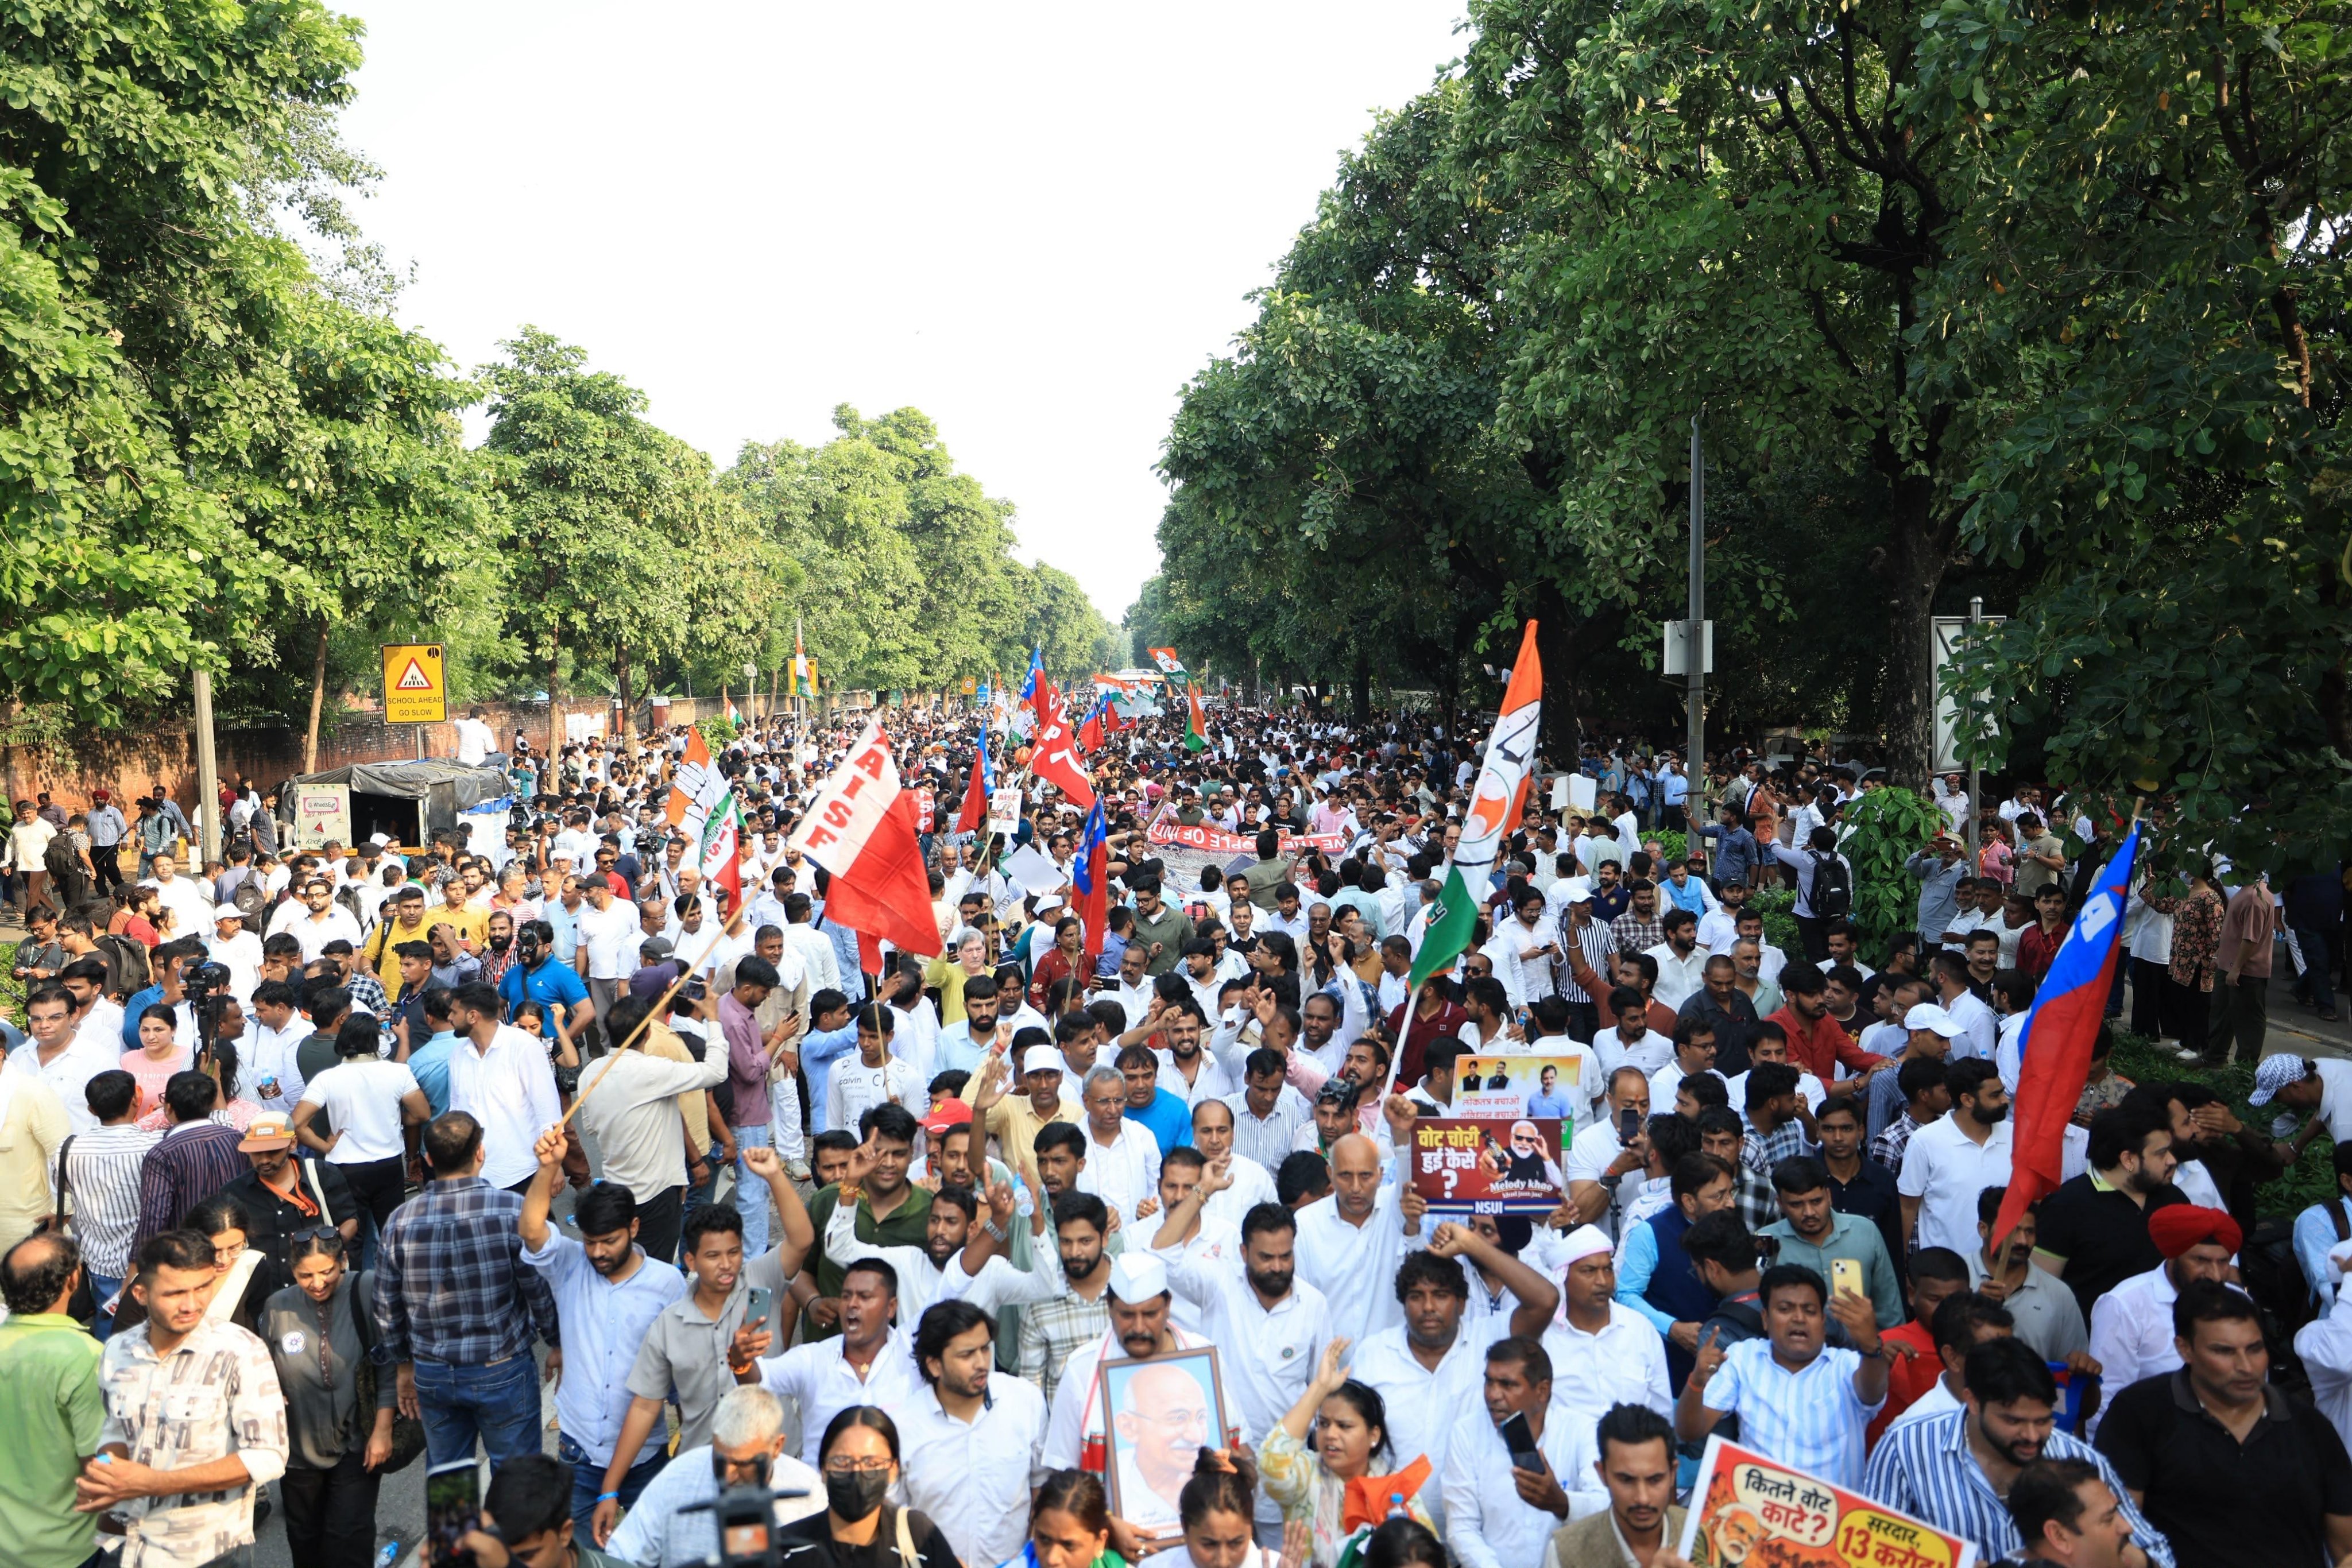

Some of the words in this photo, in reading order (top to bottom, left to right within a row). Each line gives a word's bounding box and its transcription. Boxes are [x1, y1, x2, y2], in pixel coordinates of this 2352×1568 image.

[805, 748, 885, 849] AISF
[1183, 828, 1205, 845] OF
[1321, 838, 1347, 850] WE
[839, 1077, 862, 1086] calvin
[1463, 1095, 1492, 1106] लोकतंत्र
[1494, 1095, 1519, 1106] बचाओ
[1417, 1125, 1445, 1148] वोट
[1446, 1125, 1480, 1148] चोरी
[1421, 1147, 1444, 1174] हुई
[1444, 1147, 1477, 1169] कैसे
[1441, 1169, 1458, 1199] ?
[1490, 1178, 1526, 1193] Melody
[1528, 1178, 1553, 1191] khao
[1475, 1201, 1503, 1214] NSUI
[1745, 1469, 1796, 1502] कितने
[1801, 1488, 1832, 1512] वोट
[1842, 1526, 1871, 1559] 13
[1867, 1515, 1921, 1548] सरदार,
